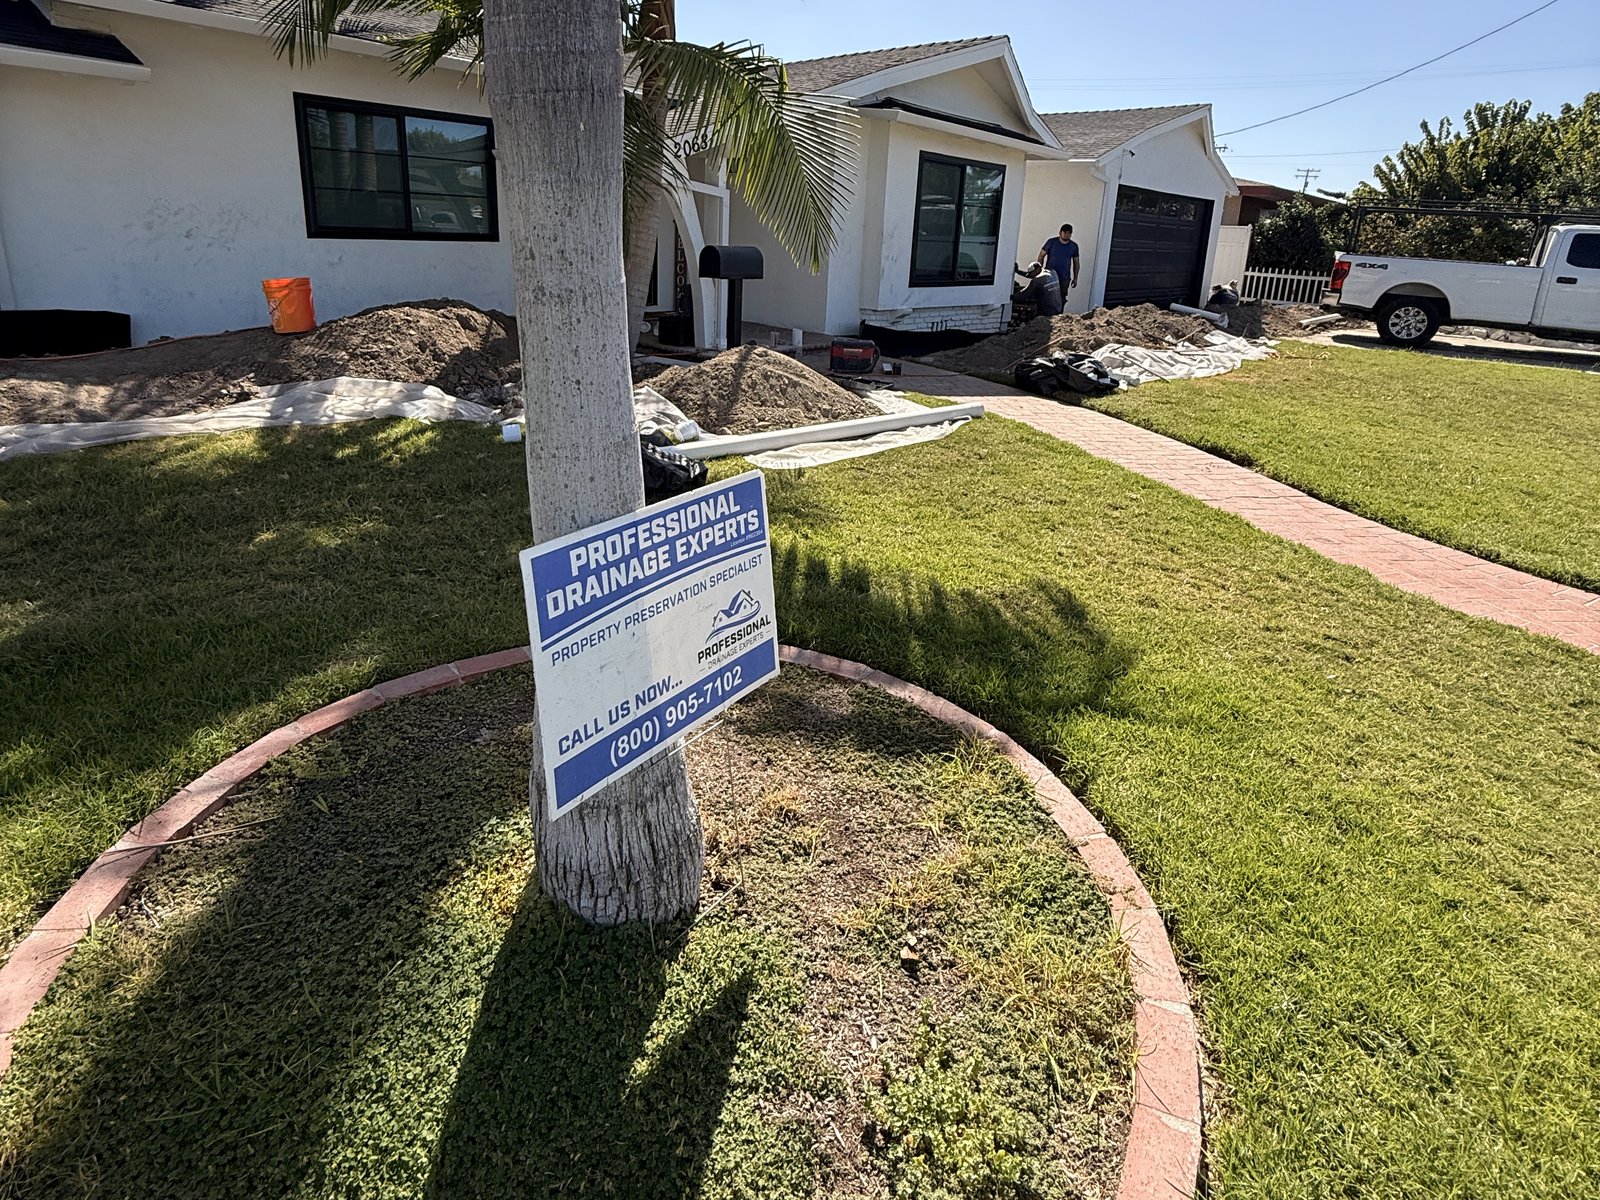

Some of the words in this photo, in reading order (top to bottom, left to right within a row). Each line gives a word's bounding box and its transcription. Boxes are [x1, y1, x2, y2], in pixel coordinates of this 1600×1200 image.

[546, 548, 672, 619] DRAINAGE
[675, 510, 760, 563] EXPERTS
[569, 491, 741, 577] PROFESSIONAL
[551, 621, 622, 666] PROPERTY
[625, 583, 707, 630] PRESERVATION
[709, 553, 763, 588] SPECIALIST
[698, 614, 771, 664] PROFESSIONAL
[707, 645, 738, 669] DRAINAGE
[740, 632, 764, 651] EXPERTS
[559, 717, 604, 755] CALL
[608, 700, 631, 726] US
[635, 675, 683, 710] NOW...
[610, 716, 660, 767] (800)
[665, 665, 743, 728] 905-7102
